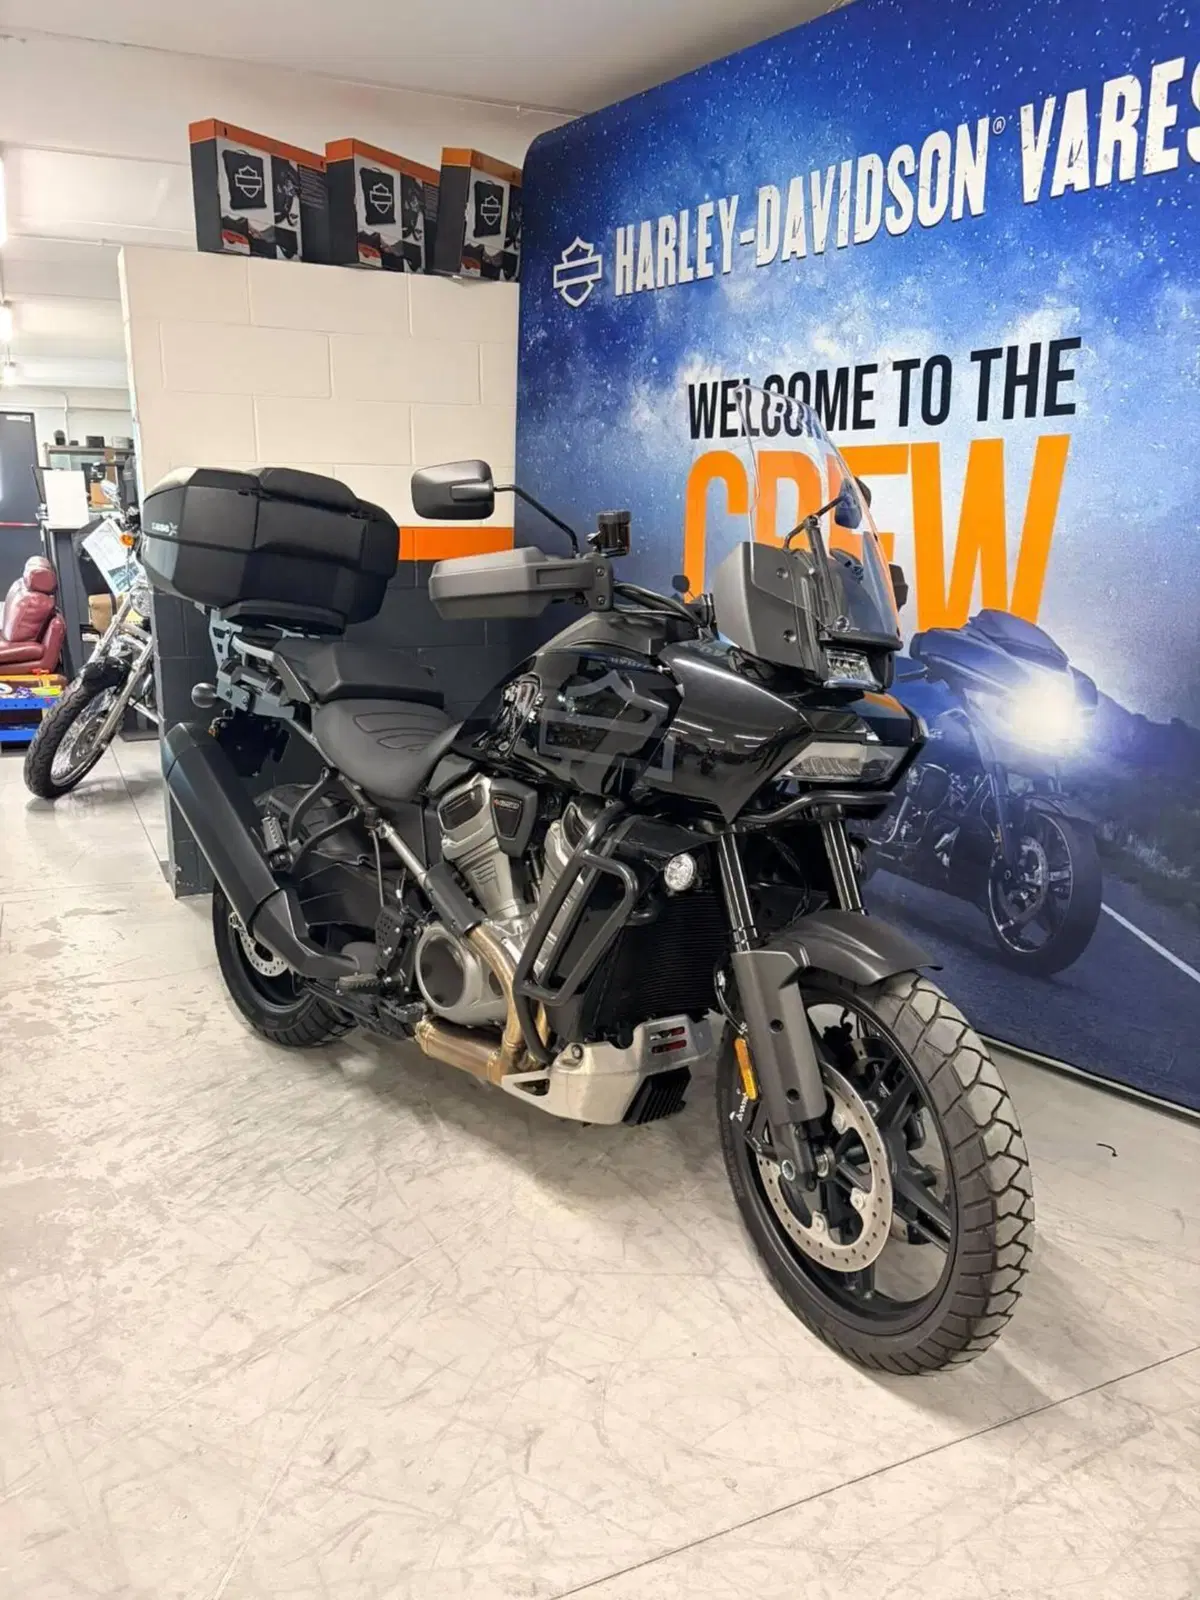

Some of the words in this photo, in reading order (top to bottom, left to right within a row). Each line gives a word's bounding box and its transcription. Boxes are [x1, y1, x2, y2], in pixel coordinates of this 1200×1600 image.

[687, 362, 879, 440] WELCOME
[892, 354, 953, 428] TO
[970, 336, 1082, 423] THE
